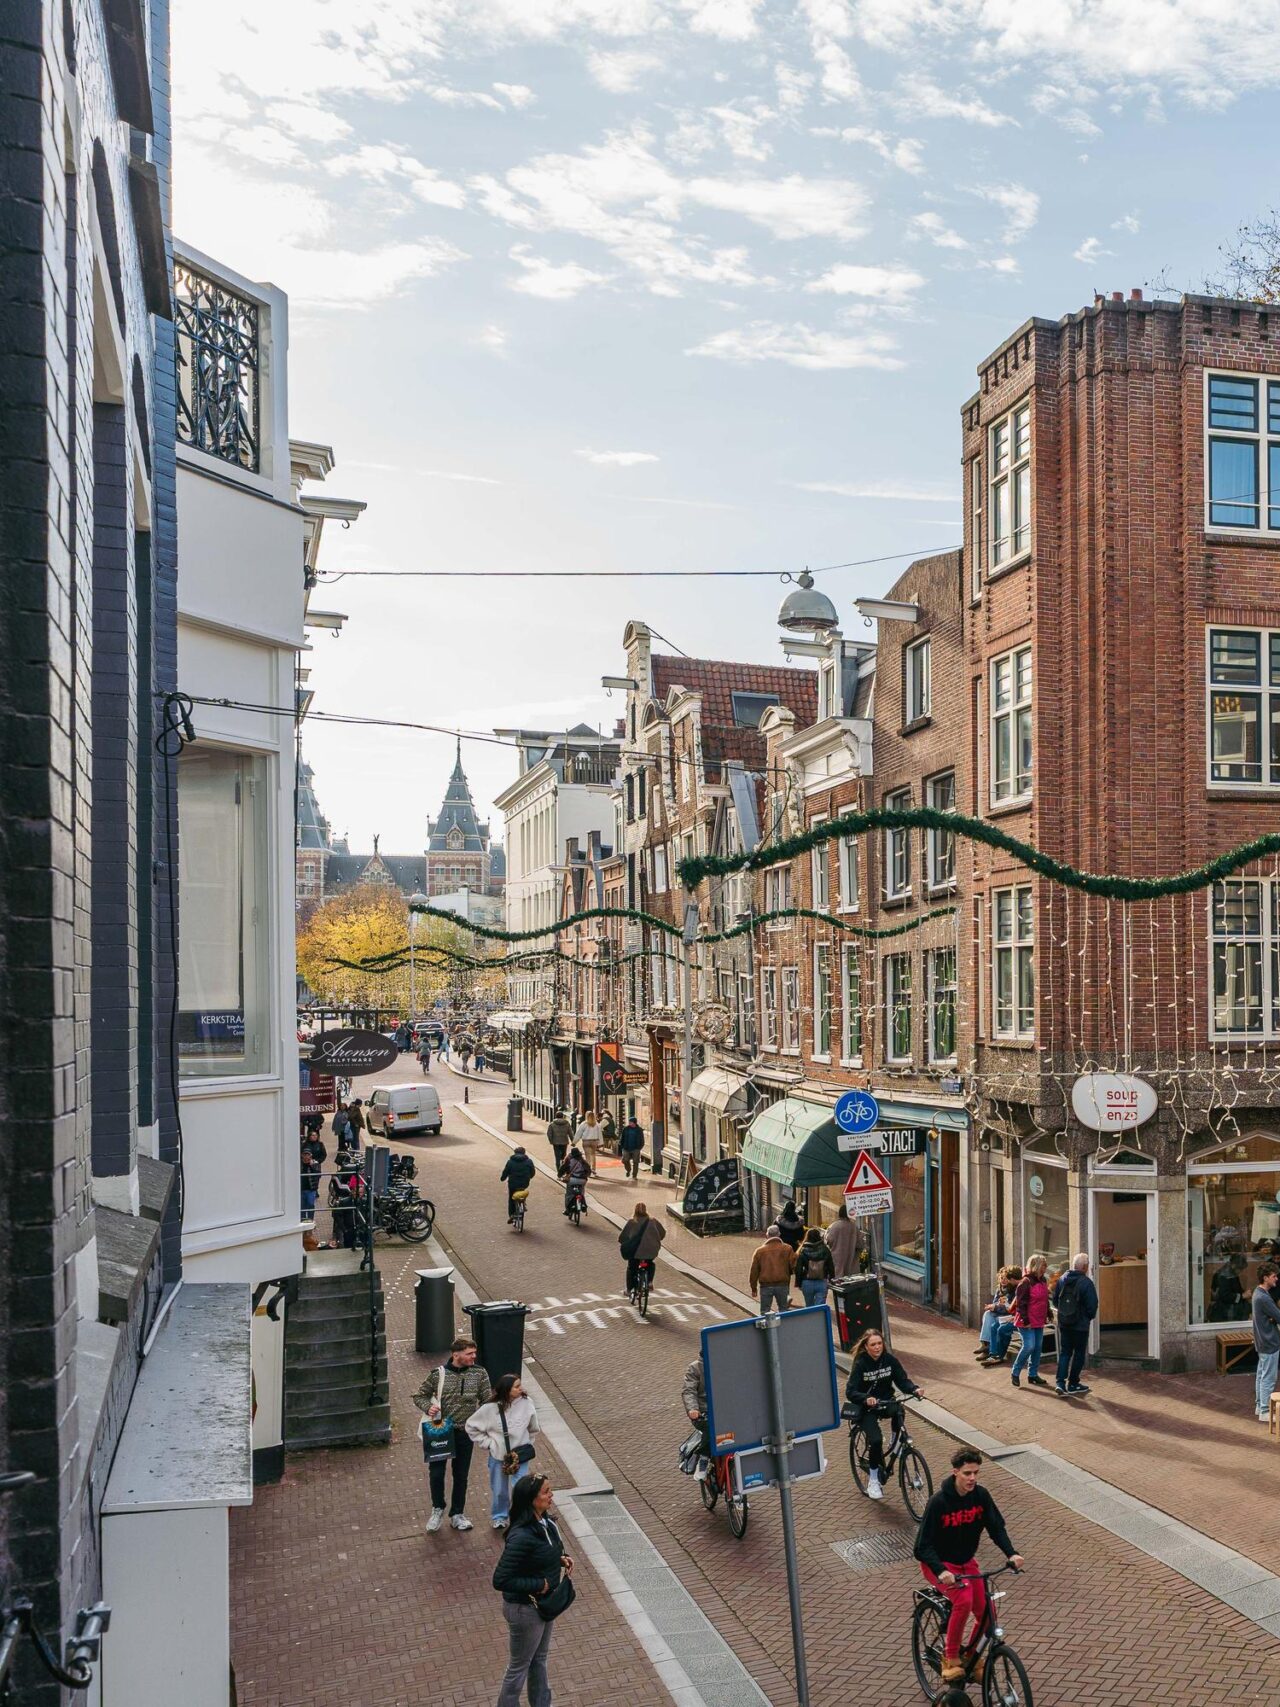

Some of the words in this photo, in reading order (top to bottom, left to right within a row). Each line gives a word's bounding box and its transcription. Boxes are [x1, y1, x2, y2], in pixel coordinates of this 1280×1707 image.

[308, 1036, 390, 1061] Aronson
[1106, 1089, 1138, 1103] soup
[1107, 1111, 1122, 1120] en
[880, 1129, 916, 1153] STACH
